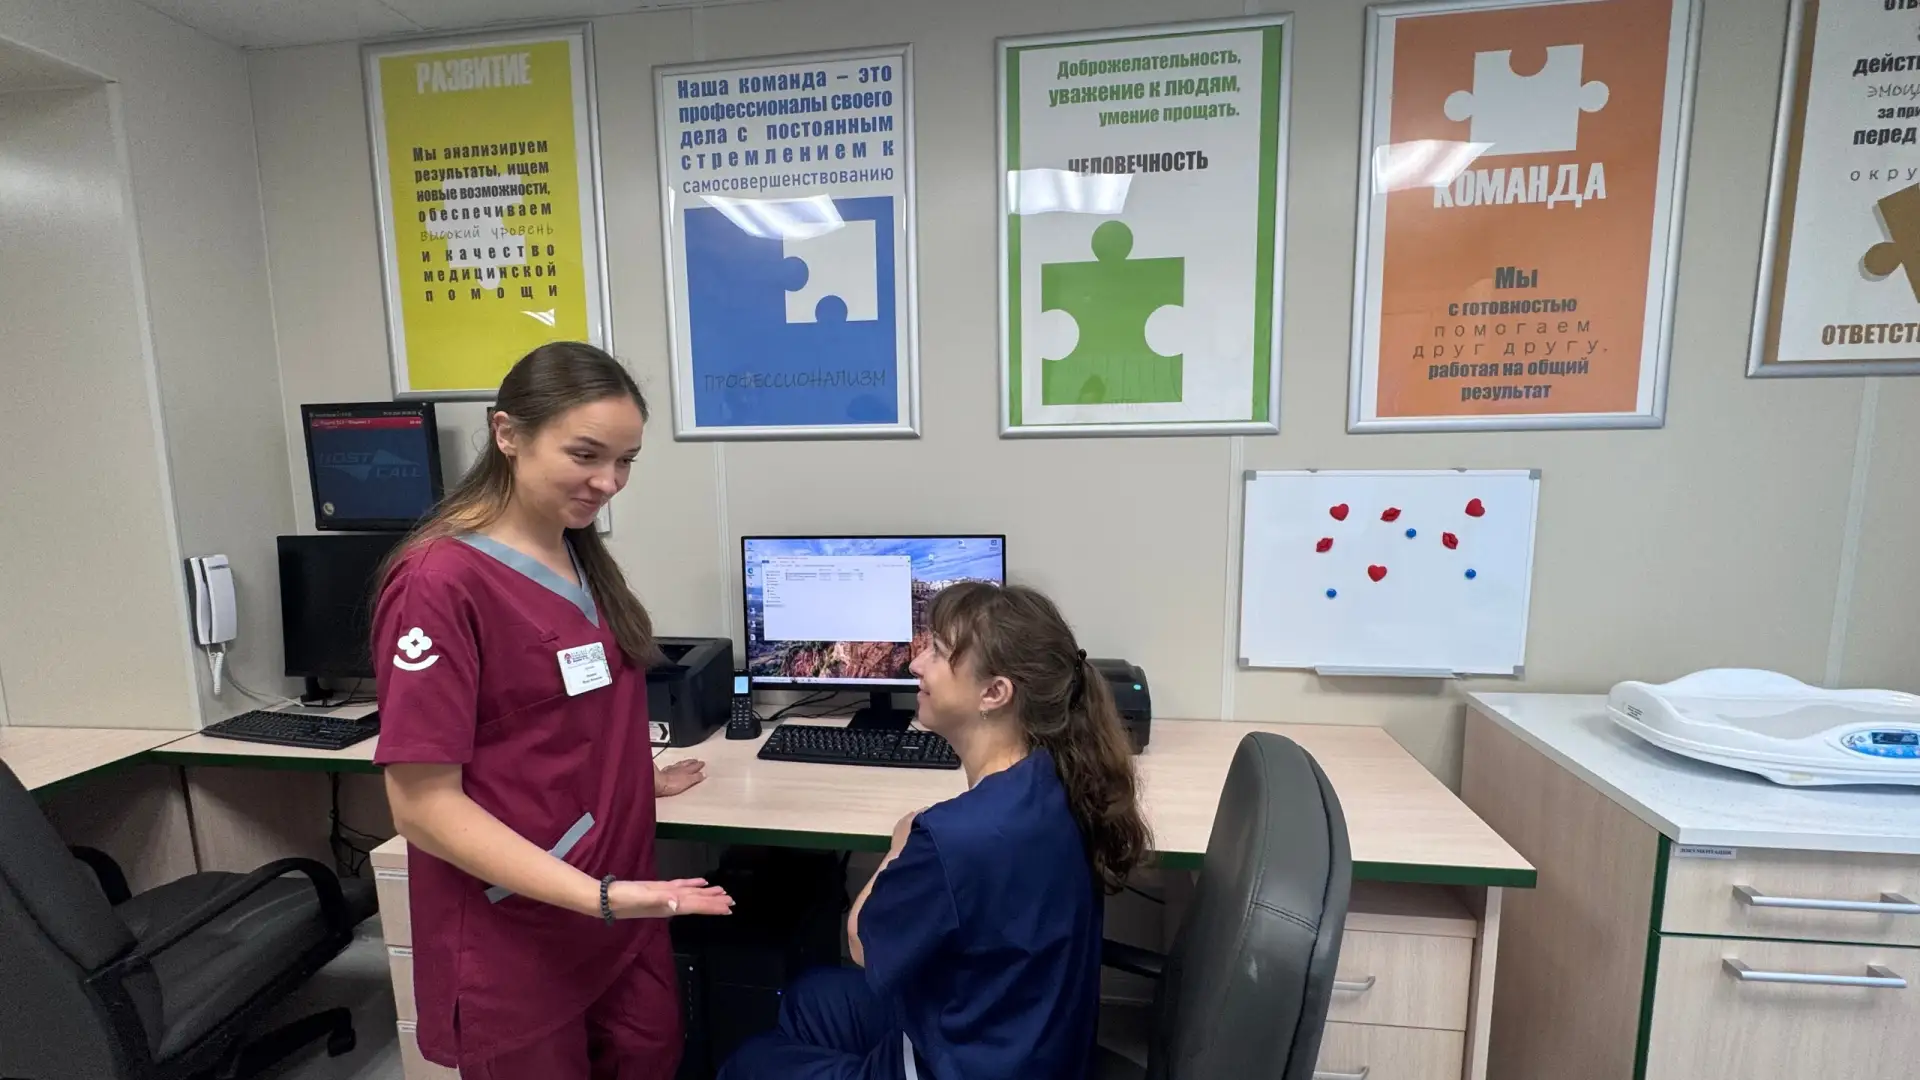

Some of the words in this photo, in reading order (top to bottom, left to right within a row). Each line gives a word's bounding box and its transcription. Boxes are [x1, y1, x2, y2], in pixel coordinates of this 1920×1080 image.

[415, 54, 531, 93] РАЗВИТИЕ
[1057, 49, 1241, 80] Доброжелательность,
[677, 79, 729, 99] Наша
[738, 70, 827, 95] команда
[858, 65, 892, 83] это
[1049, 82, 1145, 107] уважение
[1149, 81, 1160, 98] к
[1164, 75, 1241, 97] людям,
[679, 95, 827, 124] профессионалы
[831, 90, 892, 111] своего
[1099, 108, 1159, 127] умение
[1163, 102, 1240, 122] прощать.
[1877, 107, 1894, 119] за
[681, 127, 727, 150] дела
[737, 126, 748, 142] с
[766, 115, 893, 141] постоянным
[1853, 126, 1917, 146] перед
[413, 146, 437, 163] Мы
[444, 139, 548, 160] анализируем
[681, 141, 867, 171] стремлением
[883, 140, 894, 157] к
[1068, 150, 1209, 175] ЧЕЛОВЕЧНОСТЬ
[414, 164, 501, 185] результаты,
[507, 161, 549, 179] ищем
[683, 167, 894, 194] самосовершенствованию
[416, 185, 458, 203] новые
[460, 183, 551, 201] возможности,
[1433, 162, 1607, 209] КОМАНДА
[418, 202, 552, 223] обеспечиваем
[421, 224, 480, 242] высокий
[491, 223, 554, 240] уровень
[422, 250, 431, 263] и
[445, 244, 555, 262] качество
[424, 262, 557, 283] медицинской
[1495, 266, 1539, 289] Мы
[426, 284, 558, 303] помощи
[1448, 302, 1459, 317] с
[1462, 298, 1577, 317] готовностью
[1434, 319, 1591, 338] помогаем
[1413, 343, 1485, 360] друг
[704, 367, 886, 390] ПРОФЕССИОНАЛИЗМ
[1428, 361, 1499, 380] работая
[1502, 361, 1523, 376] на
[1527, 356, 1589, 378] общий
[1461, 384, 1552, 402] результат
